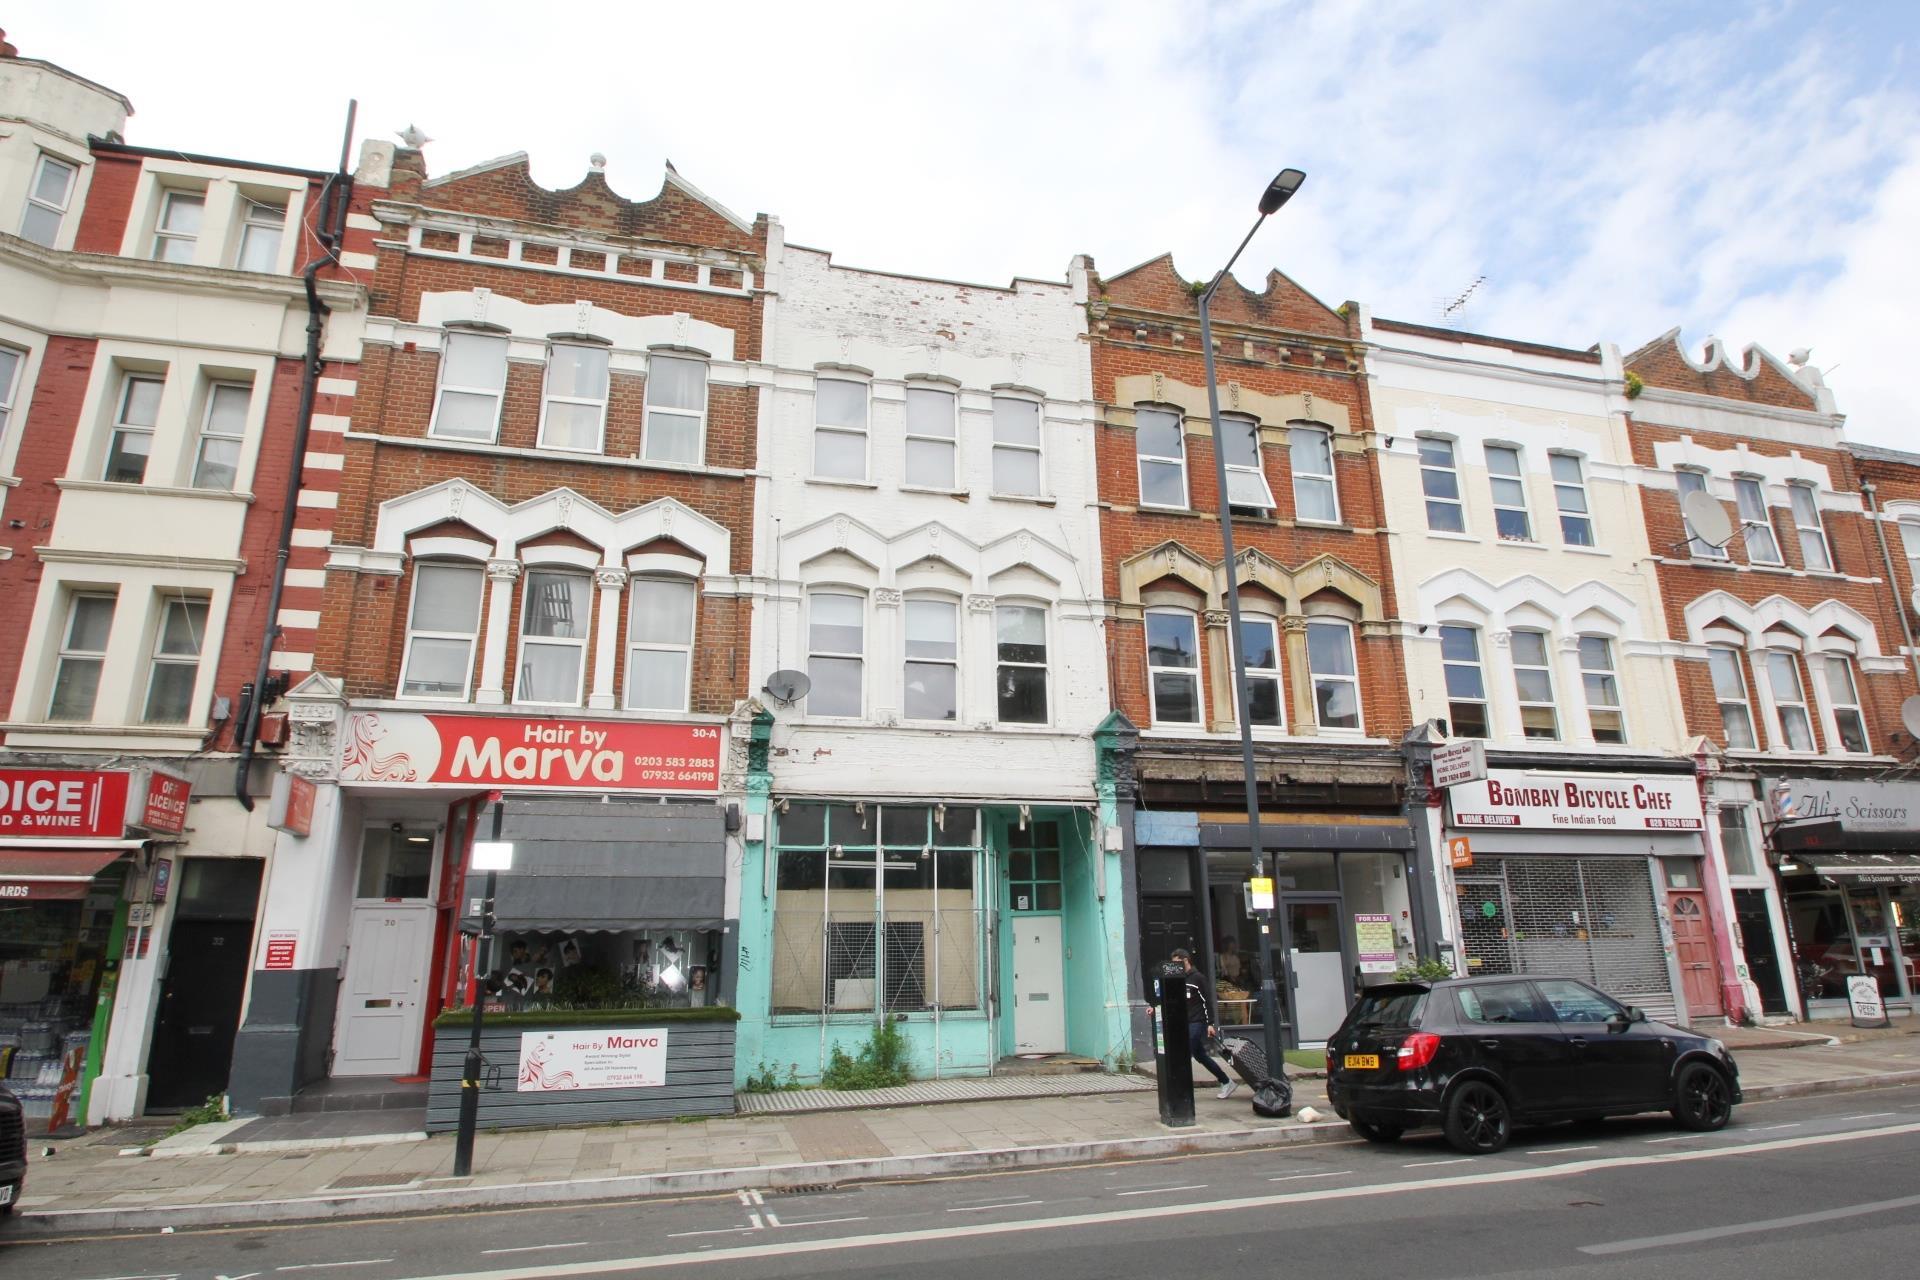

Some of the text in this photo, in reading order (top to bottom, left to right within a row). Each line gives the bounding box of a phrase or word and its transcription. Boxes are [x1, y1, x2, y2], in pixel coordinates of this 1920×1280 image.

[524, 724, 607, 750] Hair by
[692, 728, 717, 738] 30-A
[450, 736, 624, 782] Marva
[634, 756, 715, 768] 0203 583 2883
[642, 770, 714, 782] 07932 664198
[0, 780, 84, 812] ICE
[1846, 796, 1907, 818] Scissors
[21, 815, 33, 825] &
[36, 815, 81, 826] WINE
[1462, 814, 1515, 825] HOME DELIVERY
[1552, 814, 1616, 825] Fine Indian Food
[1650, 818, 1698, 828] 020 7624 0300
[607, 1036, 658, 1048] Marva
